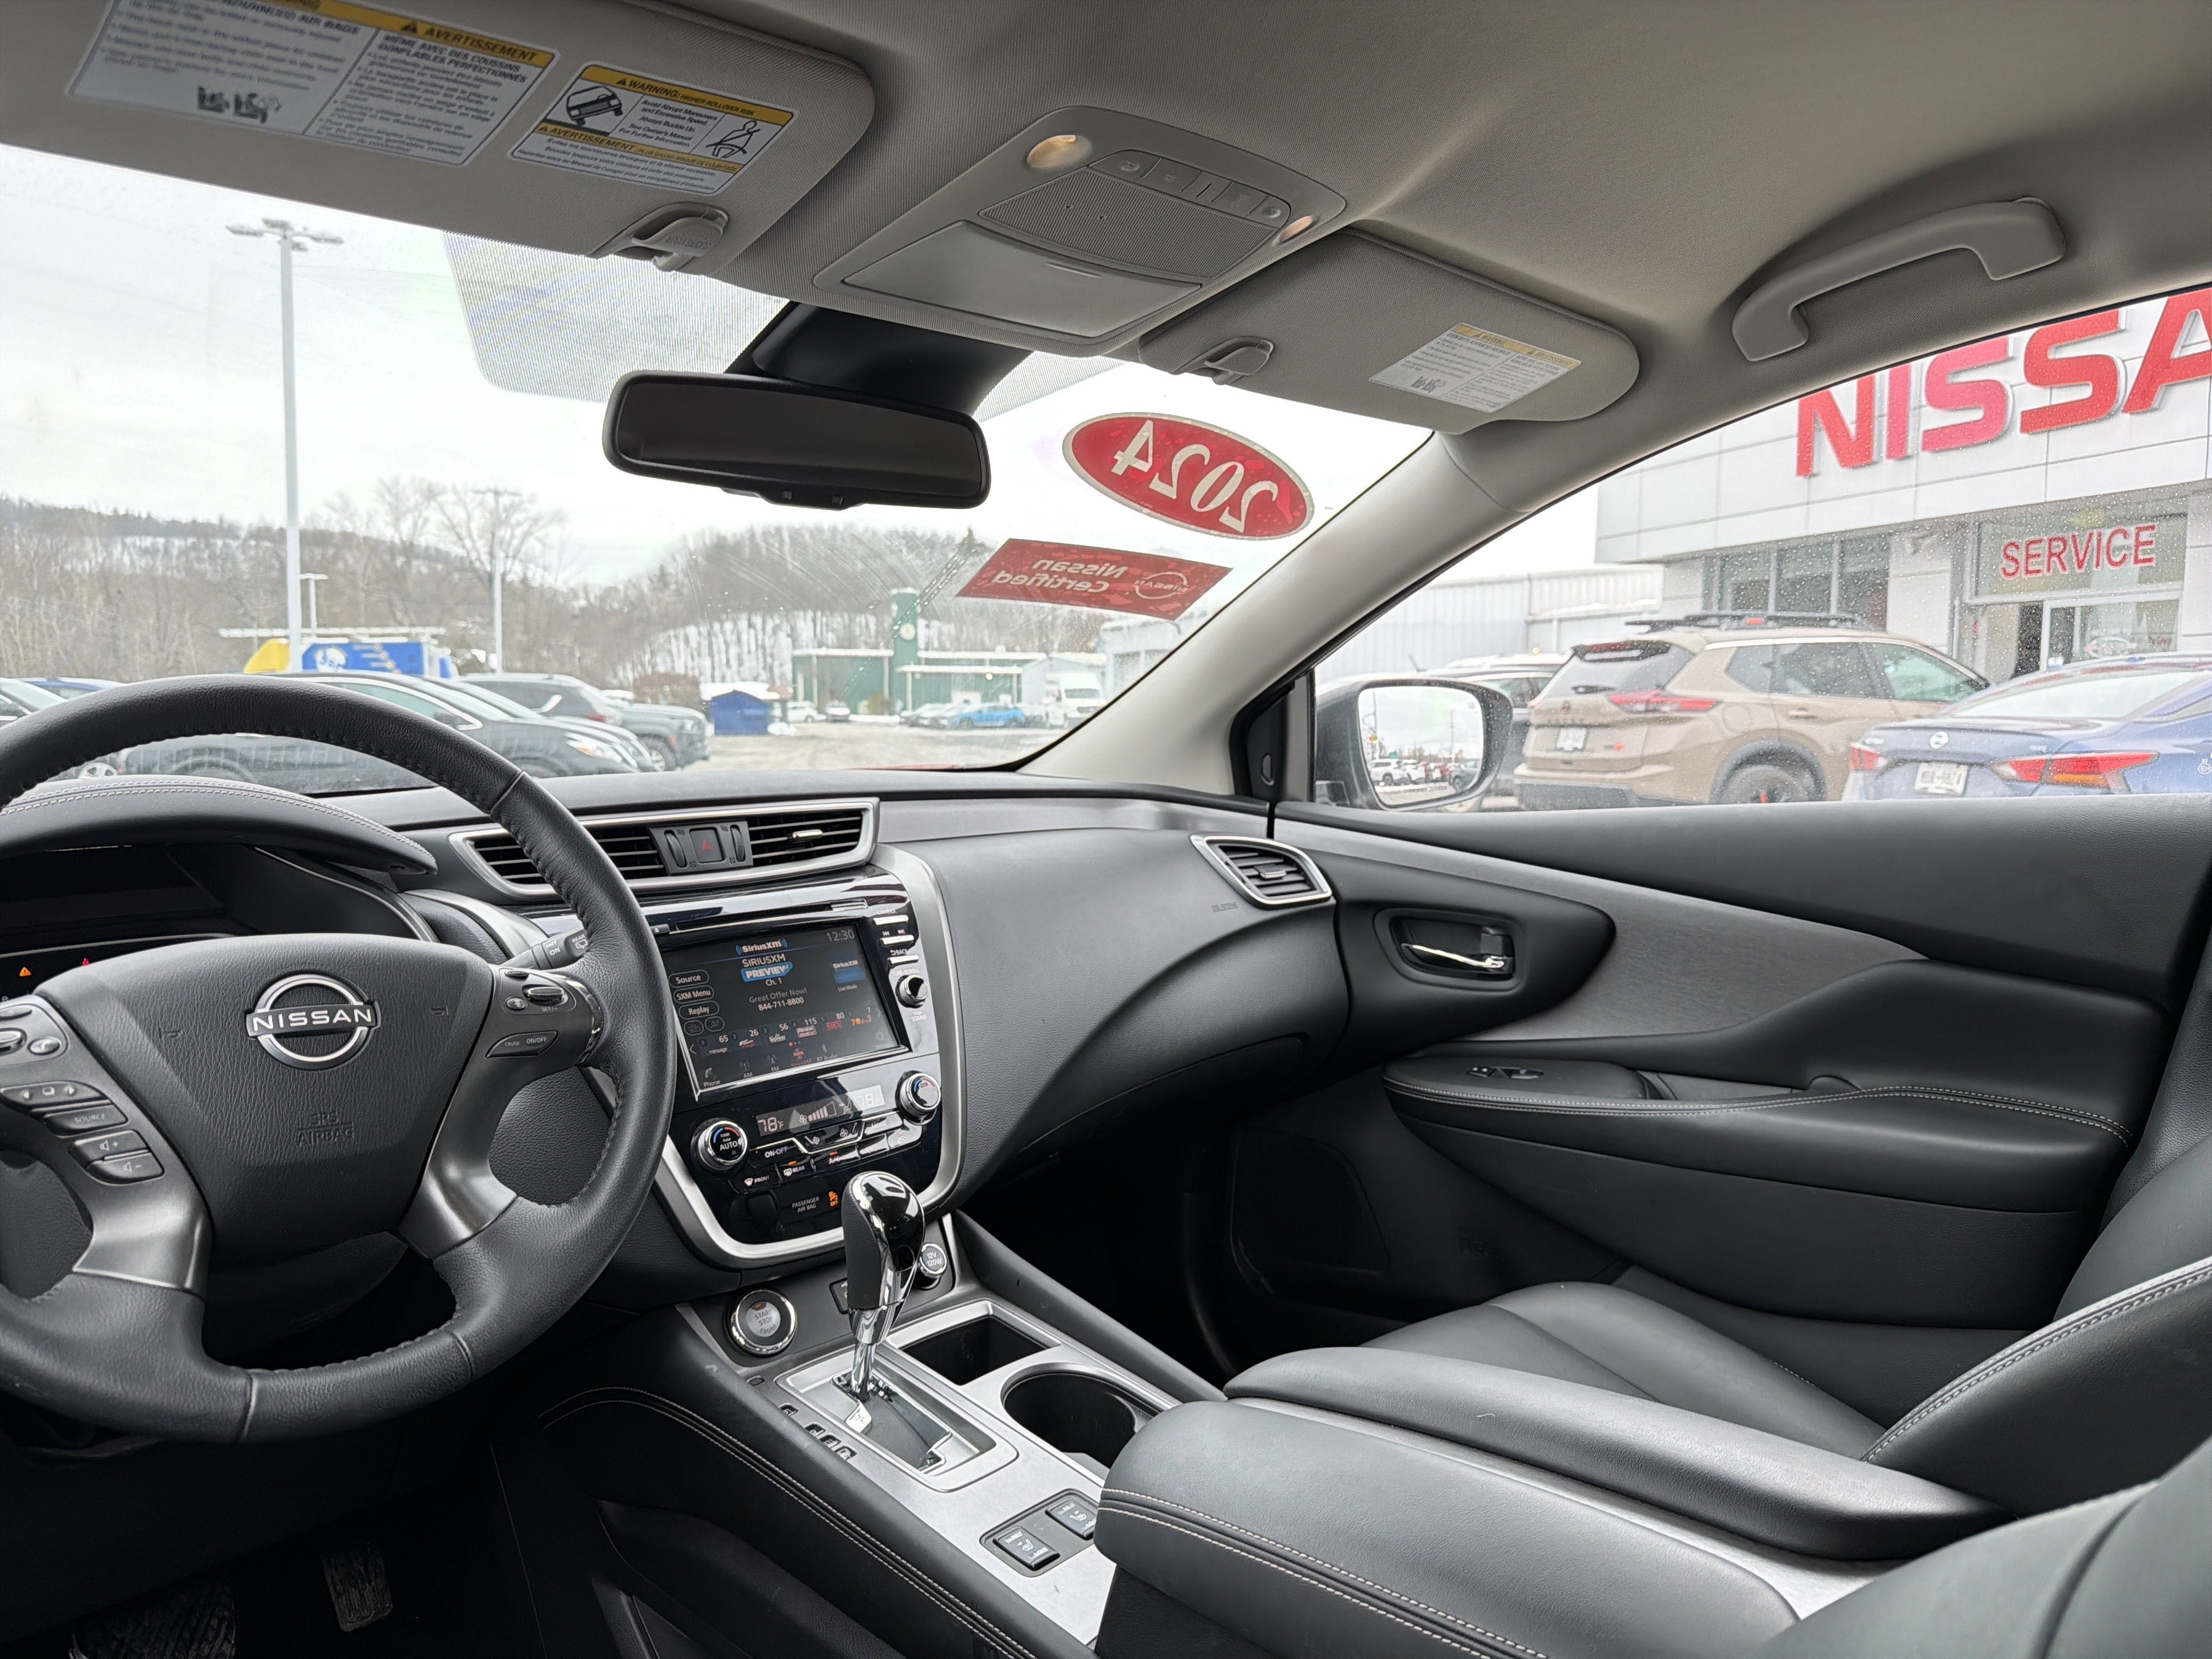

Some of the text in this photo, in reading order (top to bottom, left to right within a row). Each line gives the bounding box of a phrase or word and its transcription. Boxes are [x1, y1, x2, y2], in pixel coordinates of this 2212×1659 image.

[422, 27, 539, 61] AVERTISSEMENT
[470, 53, 524, 71] COUSSINS
[445, 58, 529, 82] PERFECTIONNÉS
[627, 80, 682, 98] WARNING:
[679, 94, 707, 104] HIGHER
[704, 100, 741, 112] ROLLOVER
[640, 99, 720, 121] Avoid Abrupt Maneuvers
[653, 109, 689, 121] Excessive
[638, 116, 664, 125] Always
[662, 121, 687, 130] Buckle
[547, 127, 637, 150] AVERTISSEMENT
[630, 131, 656, 139] Further
[641, 126, 670, 136] Owner's
[668, 132, 693, 140] Manual
[2001, 523, 2157, 580] SERVICE
[572, 934, 586, 943] REAR
[827, 929, 855, 941] 12:30
[546, 940, 557, 949] INT
[550, 947, 561, 955] ON
[742, 953, 786, 968] SIRIUSXM
[746, 964, 789, 979] PREVIEW
[675, 975, 701, 984] Source
[676, 990, 710, 1001] SXM Menu
[770, 991, 788, 1000] Offer
[789, 987, 808, 996] Now!
[758, 996, 804, 1011] 844-711-8800
[688, 1006, 709, 1015] Replay
[252, 1008, 371, 1031] NISSAN
[804, 1018, 817, 1026] 115
[779, 1023, 788, 1031] 56
[749, 1029, 759, 1037] 26
[719, 1035, 729, 1043] 65
[74, 1113, 105, 1124] SOURCE
[298, 1128, 354, 1147] AIRBAG
[720, 1142, 738, 1151] AUTO
[829, 1156, 839, 1165] A/C
[754, 1175, 770, 1183] FRONT
[792, 1196, 820, 1208] PASSENGER
[927, 1257, 942, 1267] 120W
[754, 1309, 772, 1319] START
[758, 1315, 773, 1326] STOP
[760, 1324, 777, 1334] ENGINE
